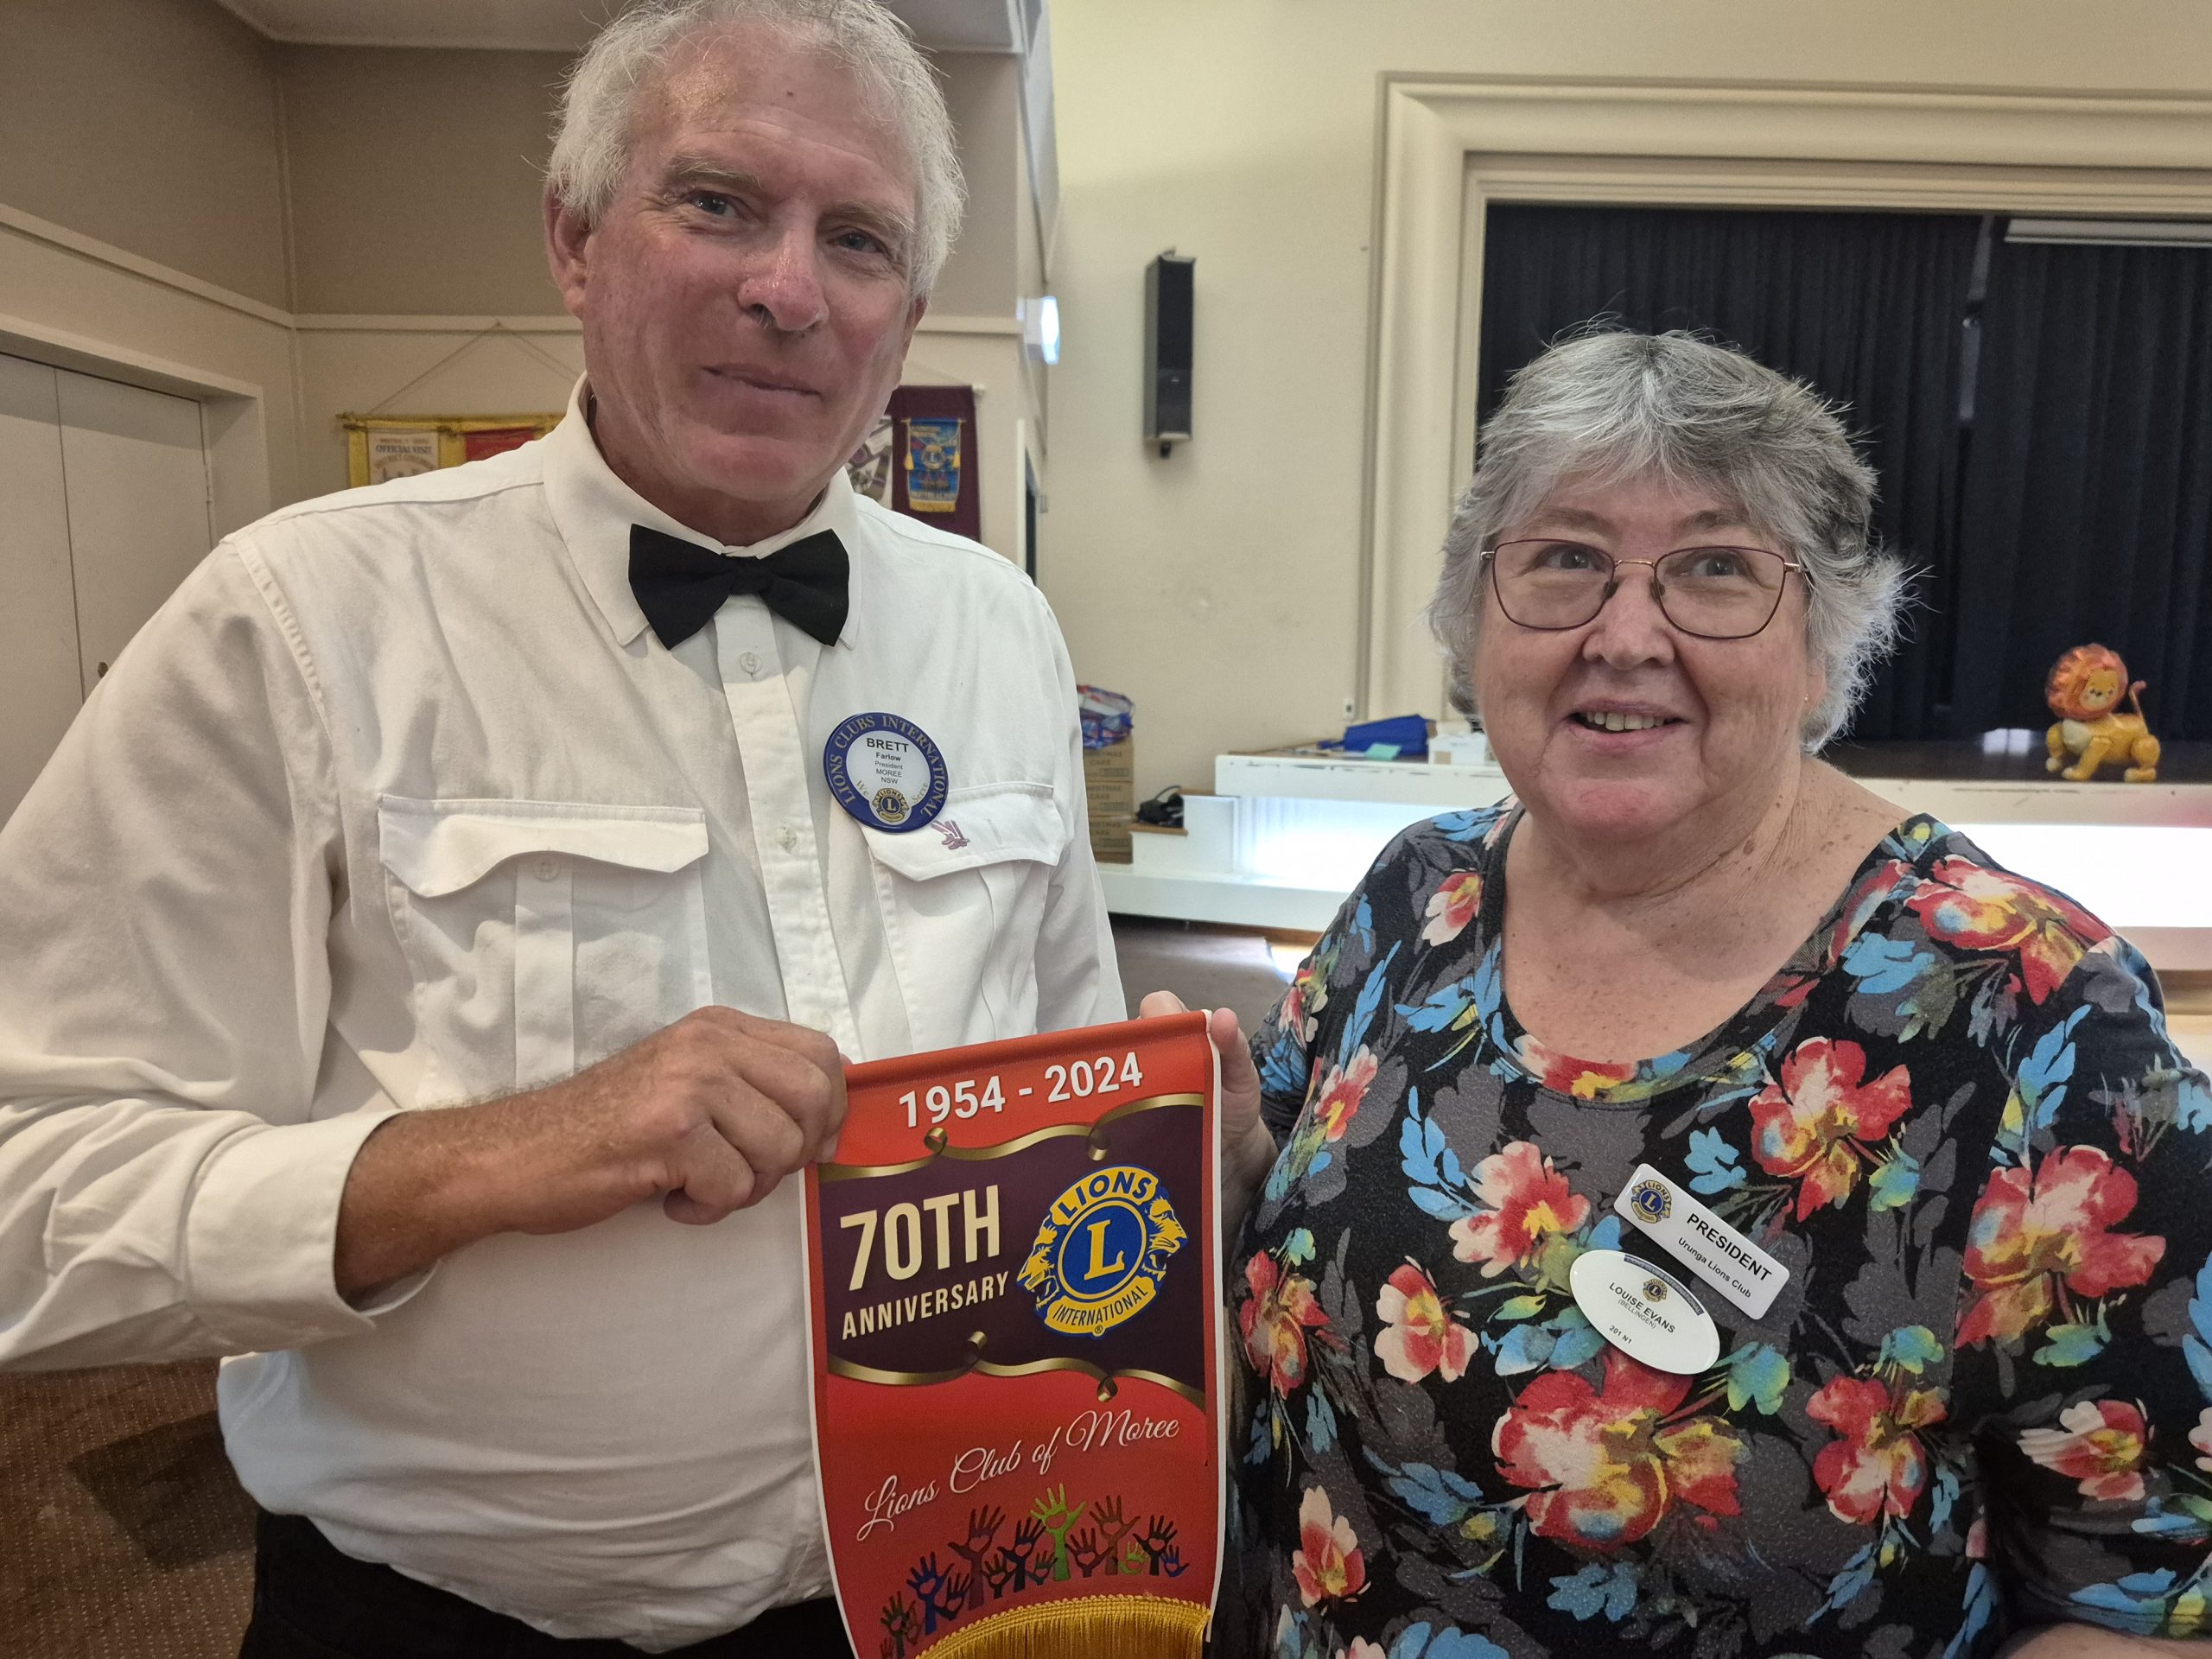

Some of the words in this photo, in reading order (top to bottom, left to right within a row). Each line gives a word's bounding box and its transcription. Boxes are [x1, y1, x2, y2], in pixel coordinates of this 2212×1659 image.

[835, 715, 875, 749] CLUBS
[867, 738, 909, 753] BRETT
[830, 753, 856, 804] LIONS
[874, 760, 903, 770] President
[875, 752, 901, 761] Farlow
[875, 769, 902, 778] MOREE
[882, 715, 946, 817] INTERNATIONAL
[887, 798, 896, 811] L
[899, 1075, 1006, 1128] 1954
[1044, 1052, 1143, 1103] 2024
[1060, 1172, 1154, 1219] LIONS
[1643, 1192, 1657, 1211] L
[1648, 1181, 1669, 1200] LIONS
[840, 1185, 1000, 1291] 70TH
[1084, 1219, 1125, 1281] L
[1687, 1213, 1772, 1281] PRESIDENT
[1678, 1237, 1707, 1264] Urunga
[1707, 1261, 1731, 1282] Lions
[1732, 1280, 1751, 1298] Club
[842, 1271, 1009, 1340] ANNIVERSARY
[1052, 1285, 1149, 1326] INTERNATIONAL
[1609, 1282, 1644, 1310] LOUISE
[1643, 1307, 1675, 1333] EVANS
[1618, 1299, 1656, 1329] (BELLINGEN)
[1609, 1325, 1622, 1337] 201
[1622, 1334, 1632, 1344] N1
[856, 1474, 941, 1541] Lions
[950, 1439, 1021, 1494] Club
[1032, 1426, 1062, 1476] of
[1065, 1409, 1179, 1452] Moree
